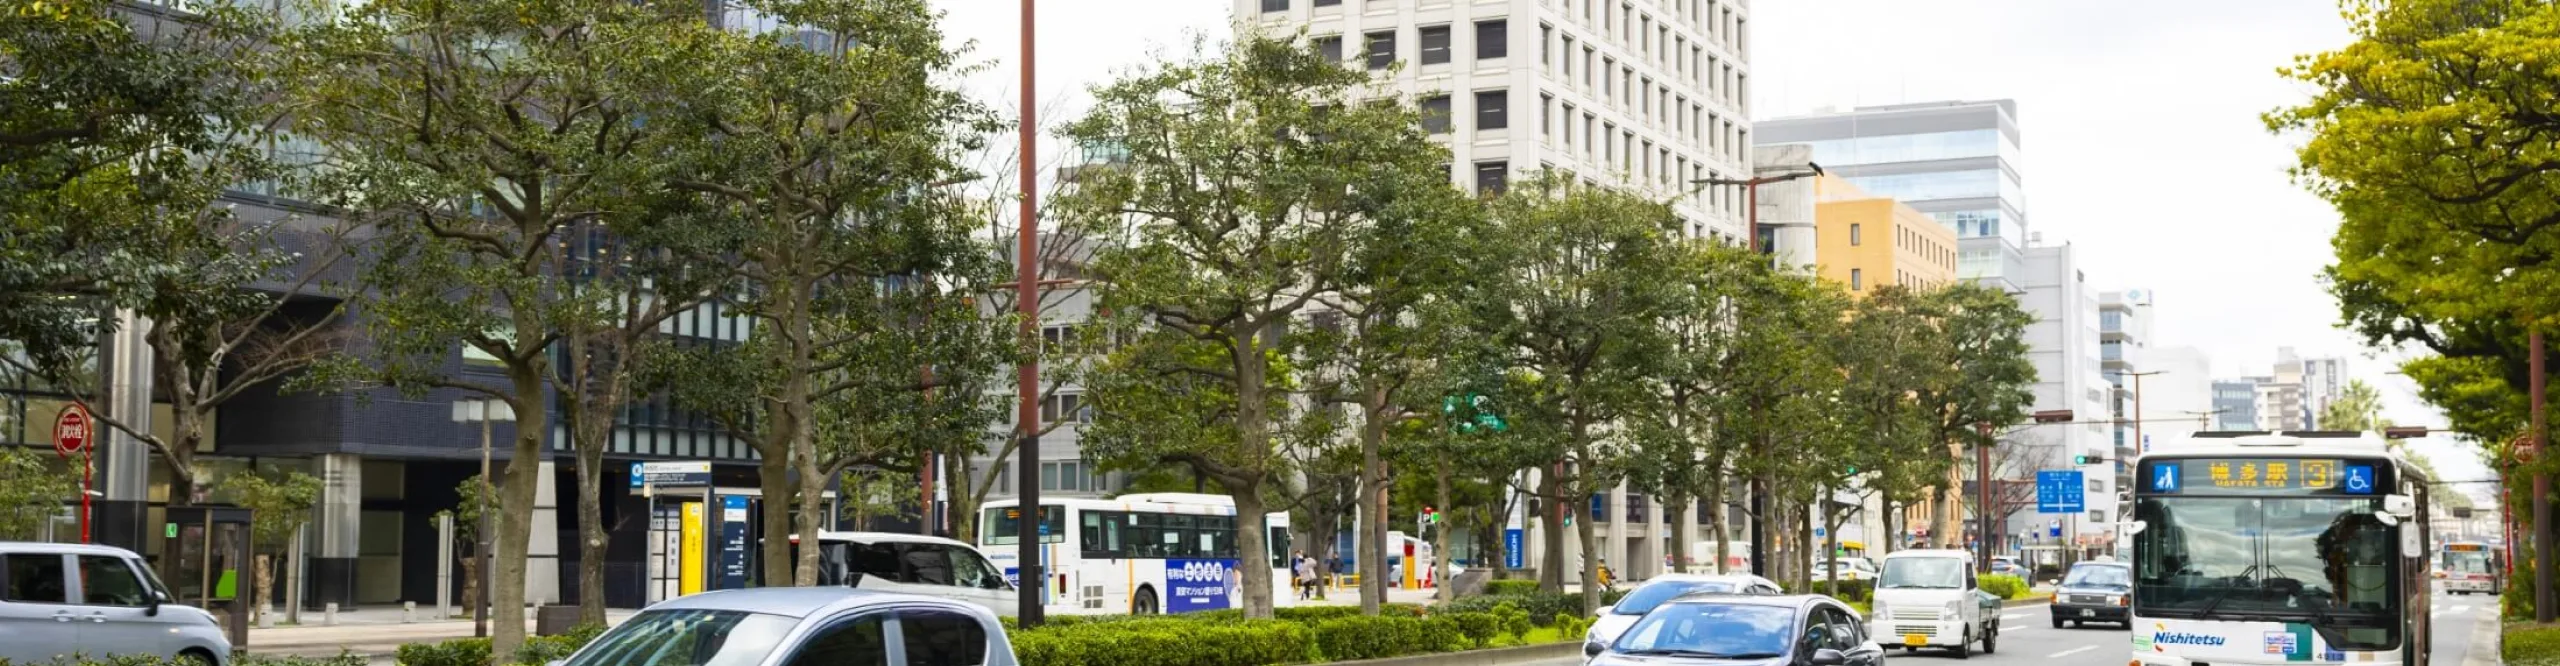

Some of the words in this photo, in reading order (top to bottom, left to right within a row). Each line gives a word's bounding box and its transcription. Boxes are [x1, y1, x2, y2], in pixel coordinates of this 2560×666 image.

[2209, 462, 2288, 480] 博多駅
[2308, 463, 2326, 486] 3
[2153, 631, 2225, 646] Nishitetsu
